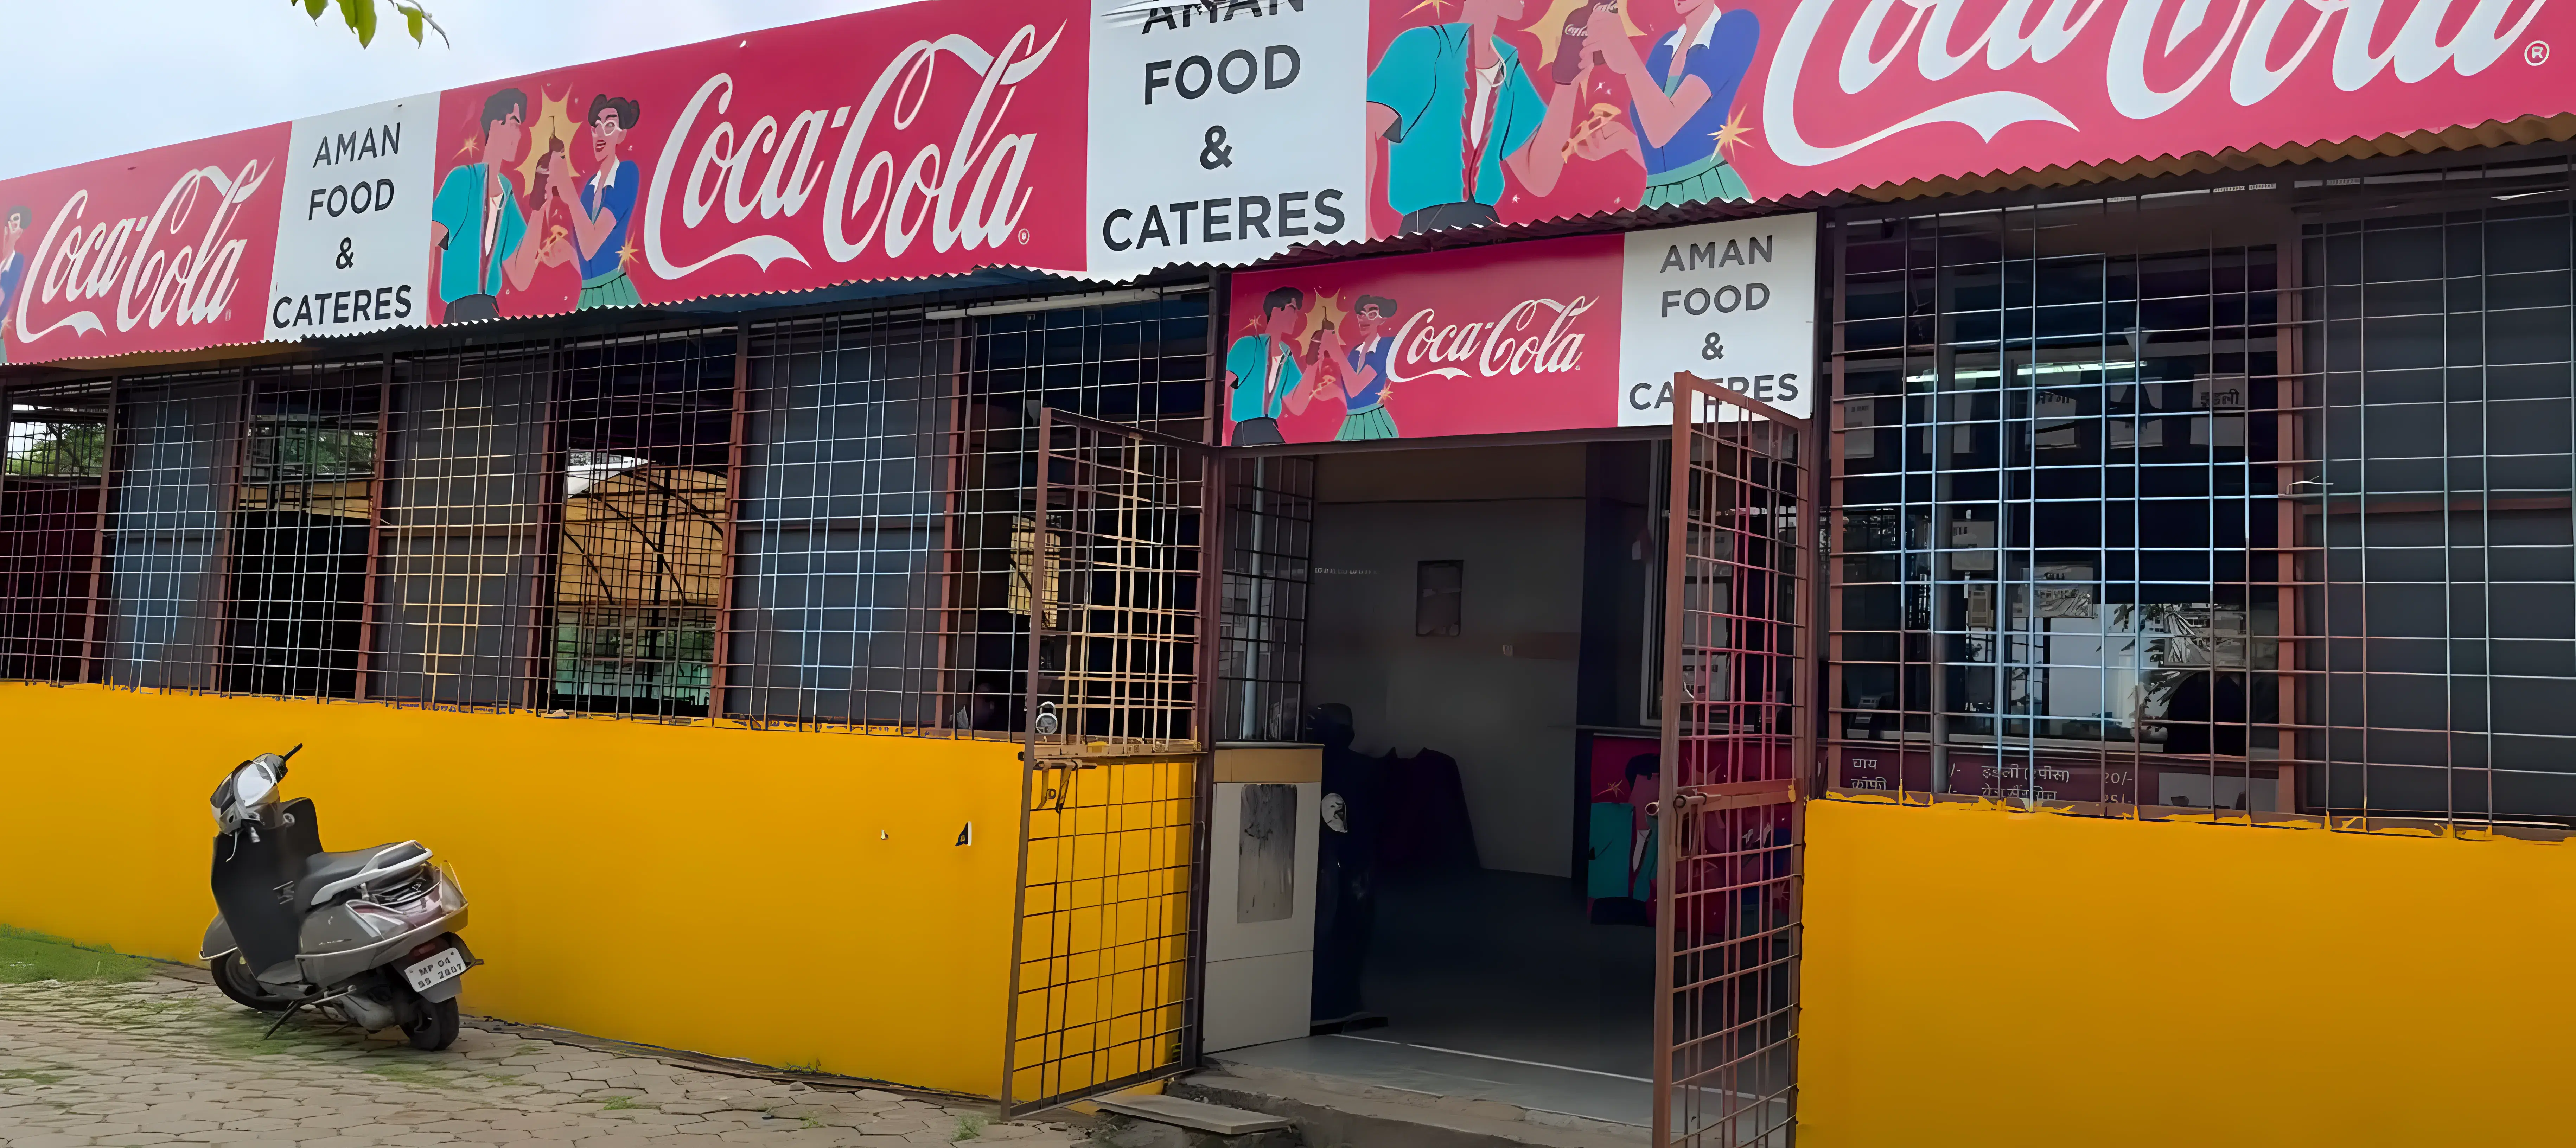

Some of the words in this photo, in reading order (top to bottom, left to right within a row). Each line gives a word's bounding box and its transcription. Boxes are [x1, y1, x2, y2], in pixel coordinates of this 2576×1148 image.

[1145, 45, 1300, 105] FOOD
[313, 122, 400, 168] AMAN
[644, 18, 1067, 280] Coca-Cola
[1200, 125, 1232, 170] &
[308, 178, 394, 220] FOOD
[1103, 189, 1345, 251] CATERES
[16, 157, 275, 343] Coca-Cola
[336, 237, 354, 269] &
[1660, 235, 1772, 273] AMAN
[273, 285, 411, 329] CATERES
[1662, 283, 1770, 317] FOOD
[1386, 296, 1599, 382] Coca-Cola
[1702, 332, 1724, 360] &
[1629, 373, 1798, 410] CAERES
[1852, 759, 1877, 769] चाय
[418, 964, 433, 976] MP
